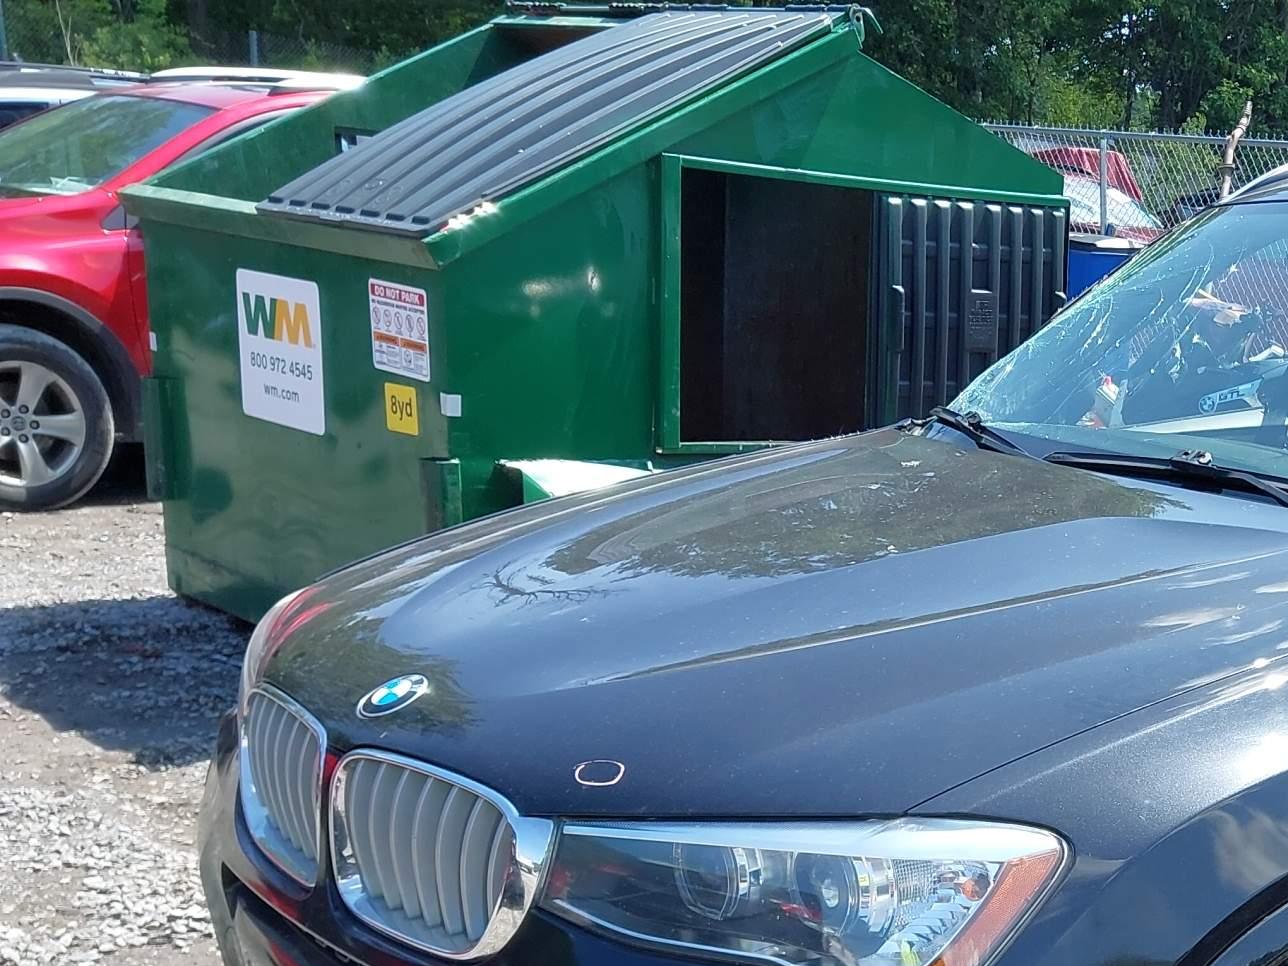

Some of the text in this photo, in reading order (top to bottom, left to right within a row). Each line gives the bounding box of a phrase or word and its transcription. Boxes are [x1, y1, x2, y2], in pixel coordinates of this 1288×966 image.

[374, 285, 421, 305] DO NOT PARK
[242, 291, 313, 349] WM
[250, 351, 313, 381] 800 972 4545
[264, 383, 300, 403] wm.com
[390, 395, 413, 421] 8yd
